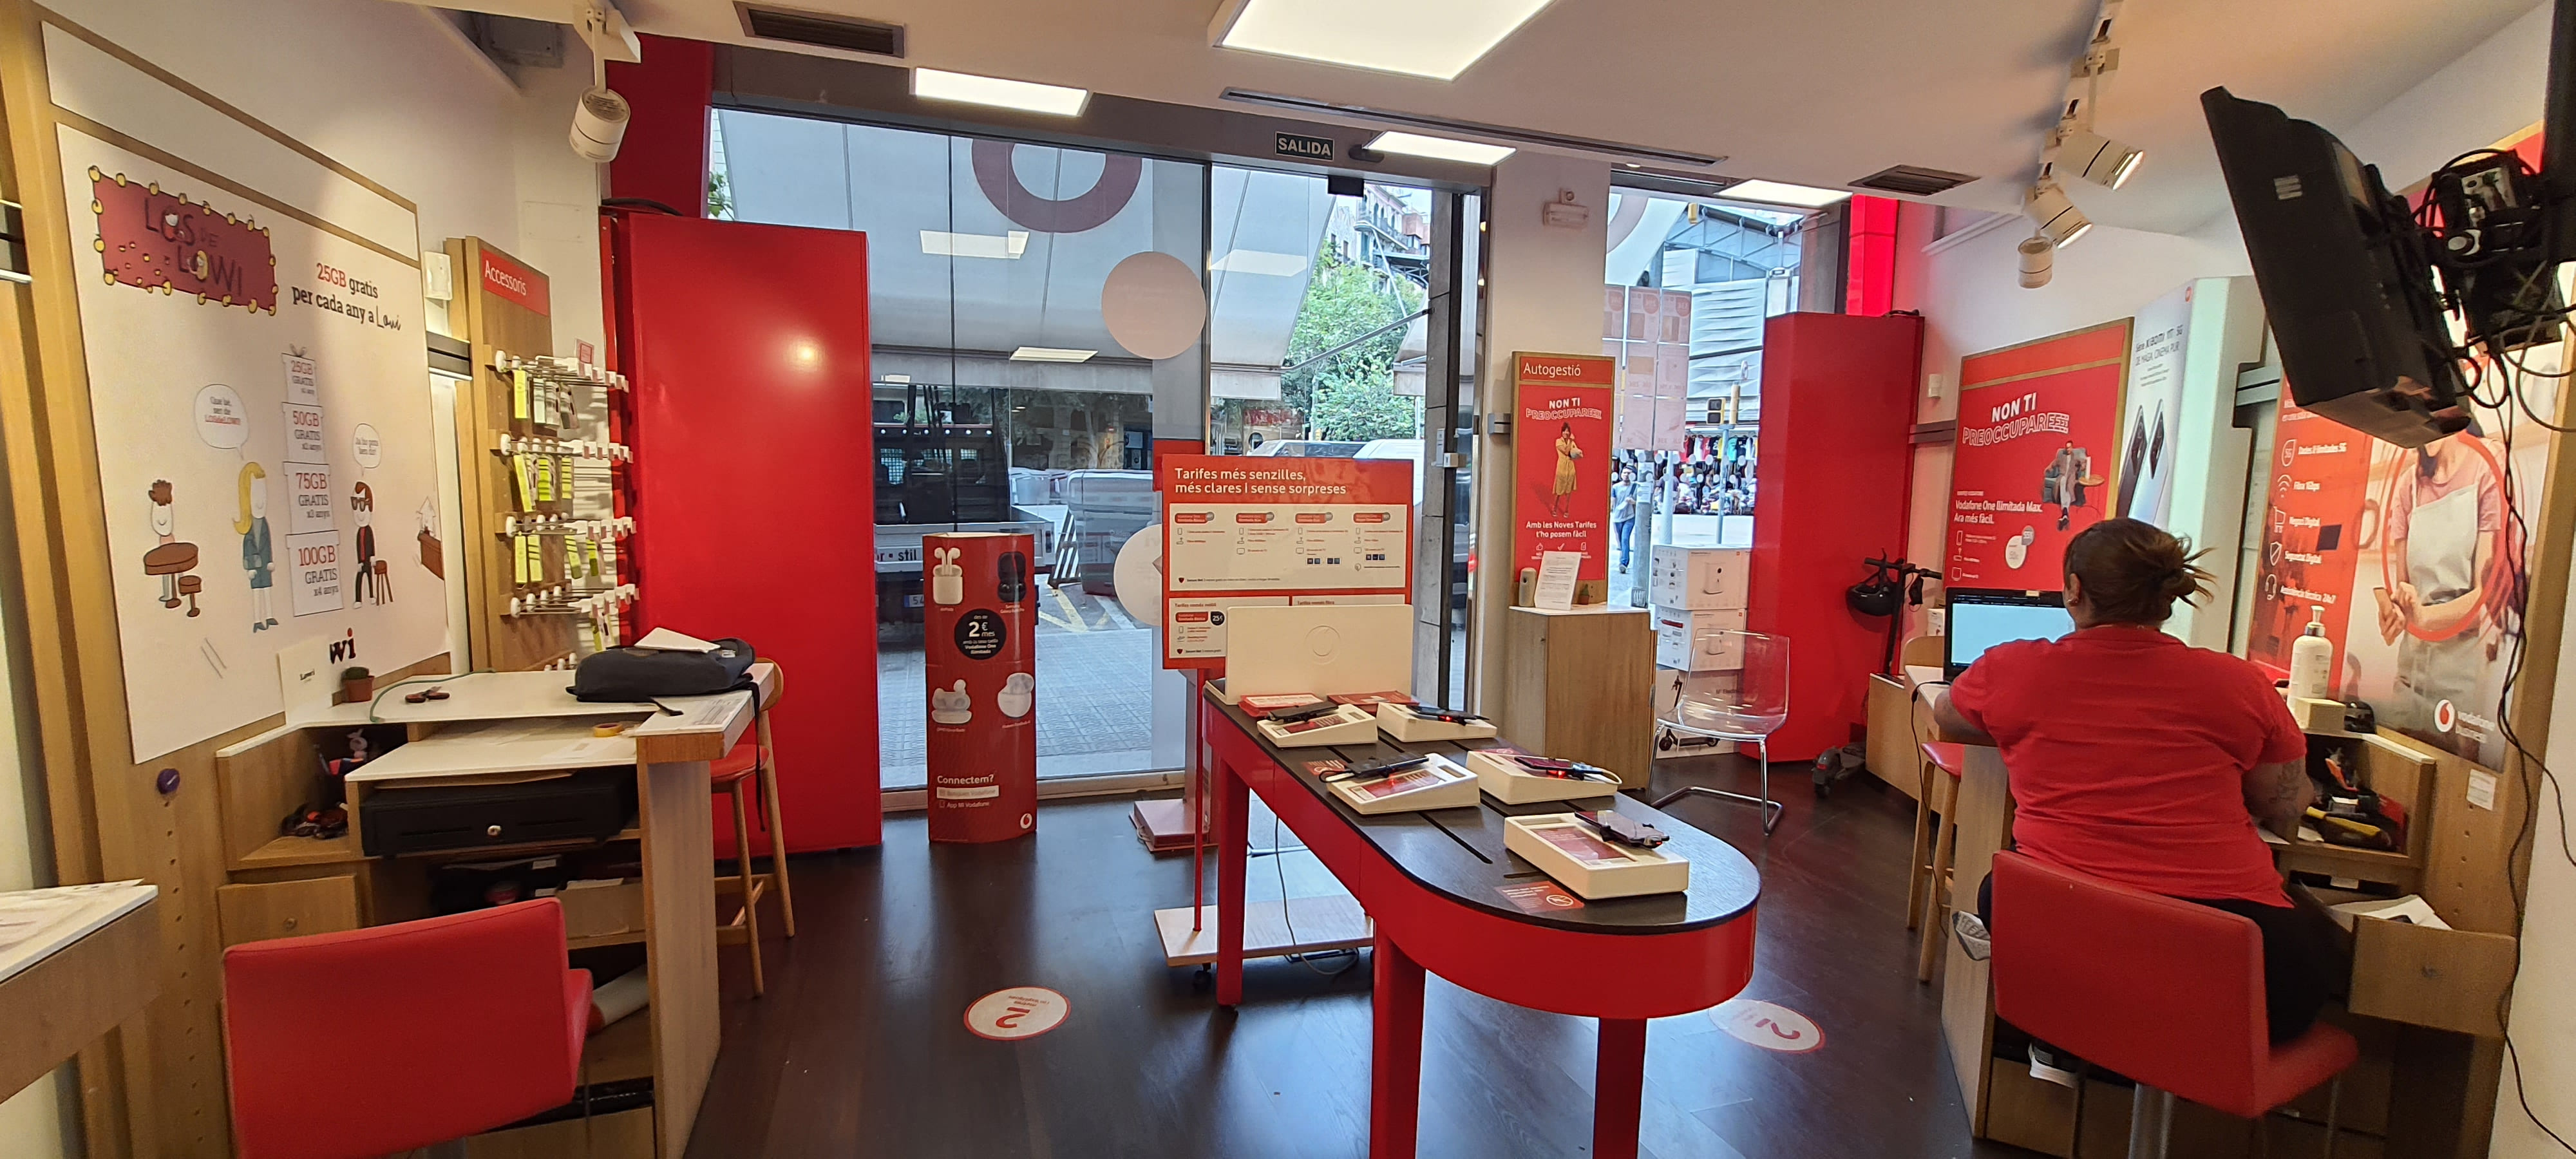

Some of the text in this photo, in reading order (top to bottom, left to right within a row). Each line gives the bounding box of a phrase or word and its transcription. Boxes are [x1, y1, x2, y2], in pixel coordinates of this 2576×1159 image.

[1278, 138, 1331, 156] SALIDA
[316, 263, 378, 299] 25GB gratis
[485, 260, 526, 296] Accessoris
[291, 287, 313, 305] per
[316, 294, 344, 314] cada
[346, 303, 366, 324] any
[368, 311, 374, 323] a
[291, 360, 313, 375] 25GB
[1523, 363, 1580, 378] Autogestió
[1549, 397, 1580, 409] NON TI
[1991, 392, 2037, 422] NON TI
[292, 410, 319, 427] 50GB
[294, 429, 320, 440] GRATIS
[296, 473, 327, 490] 75GB
[1175, 467, 1306, 481] Tarifes més senzilles,
[1175, 482, 1202, 493] més
[1204, 482, 1242, 493] clares
[1251, 484, 1286, 494] sense
[1289, 484, 1347, 496] sorpreses
[298, 495, 328, 506] GRATIS
[1955, 500, 1982, 510] Vodafone
[1983, 500, 1995, 511] One
[1954, 513, 1964, 522] Ara
[1965, 514, 1978, 523] més
[298, 545, 336, 567] 100GB
[898, 549, 917, 561] stil
[305, 568, 337, 585] GRATIS
[314, 585, 339, 596] x4 anys
[969, 621, 988, 637] 2 €
[329, 627, 356, 664] wi
[937, 774, 994, 784] Connectem?
[996, 1007, 1030, 1028] 2
